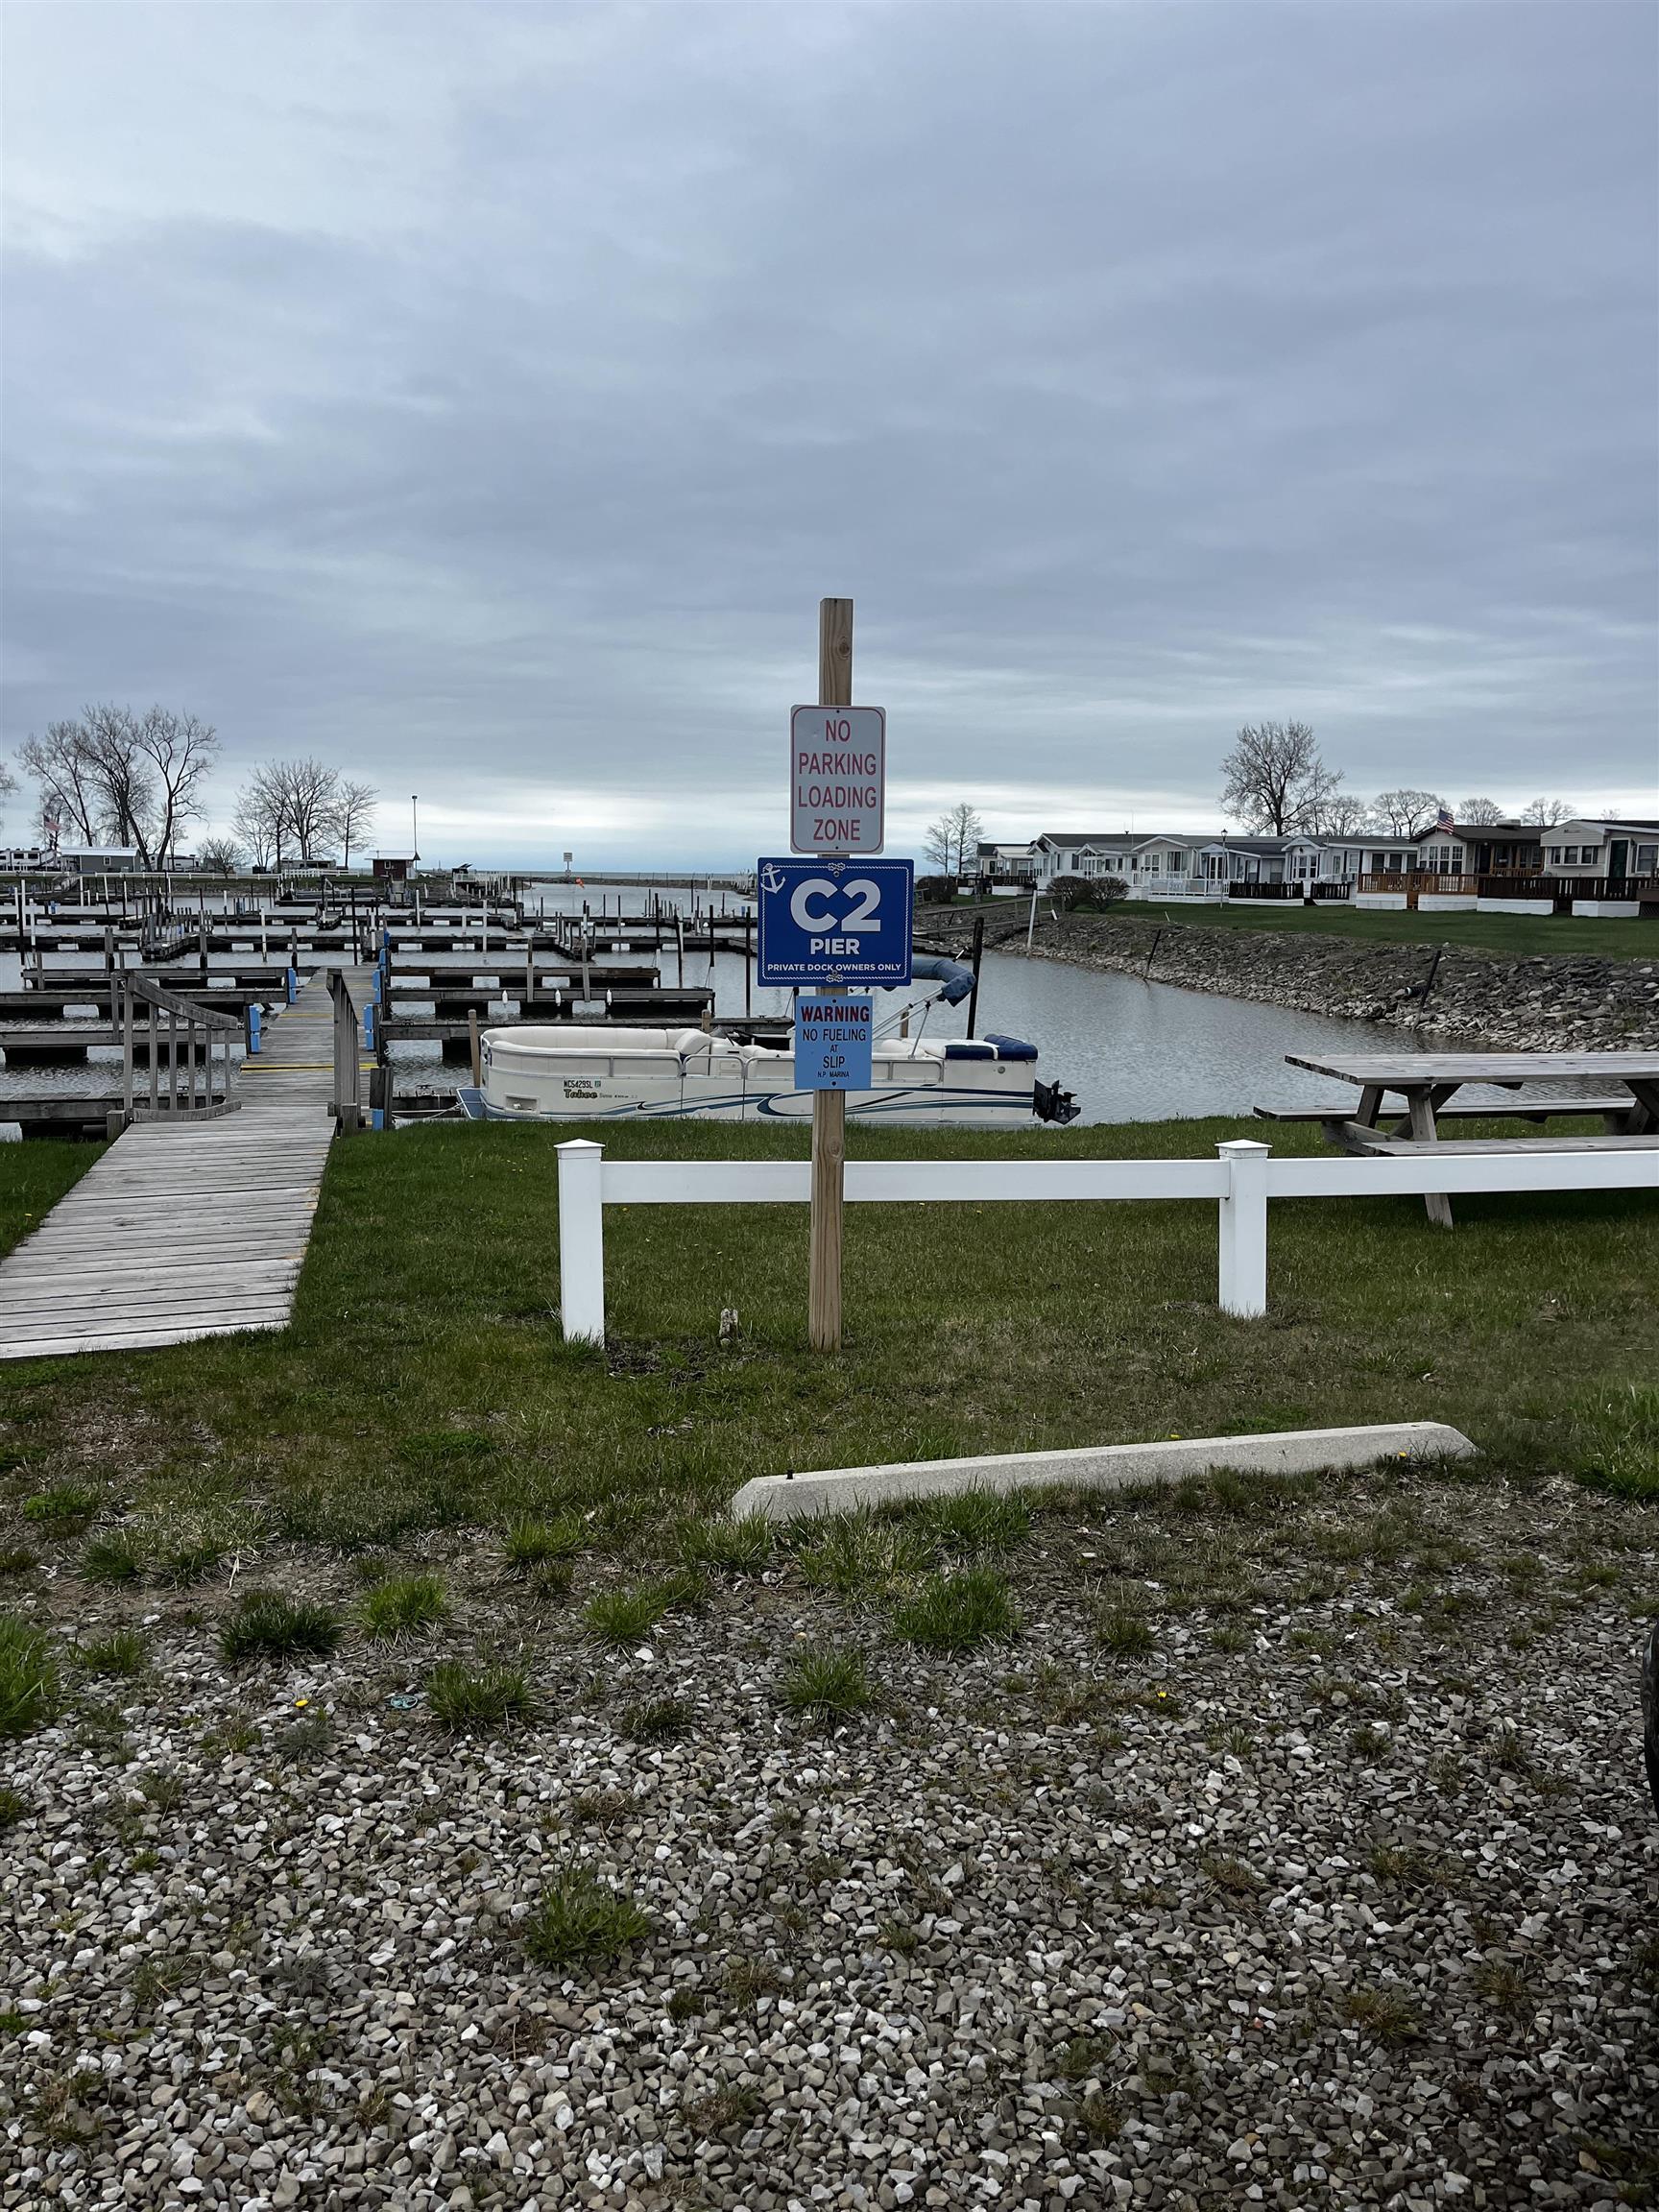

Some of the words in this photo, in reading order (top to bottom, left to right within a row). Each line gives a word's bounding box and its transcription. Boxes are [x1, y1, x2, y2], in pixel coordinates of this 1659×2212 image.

[826, 720, 851, 741] NO
[799, 753, 876, 775] PARKING
[798, 785, 876, 807] LOADING
[813, 819, 860, 840] ZONE
[790, 878, 881, 932] C2
[810, 938, 860, 955] PIER
[768, 963, 805, 972] PRIVATE
[807, 963, 832, 972] DOCK
[835, 963, 876, 972] OWNERS
[878, 963, 902, 972] ONLY
[801, 1005, 870, 1022] WARNING
[803, 1028, 818, 1042] NO
[823, 1028, 866, 1042] FUELING
[830, 1044, 838, 1053] AT
[823, 1055, 845, 1069] SLIP
